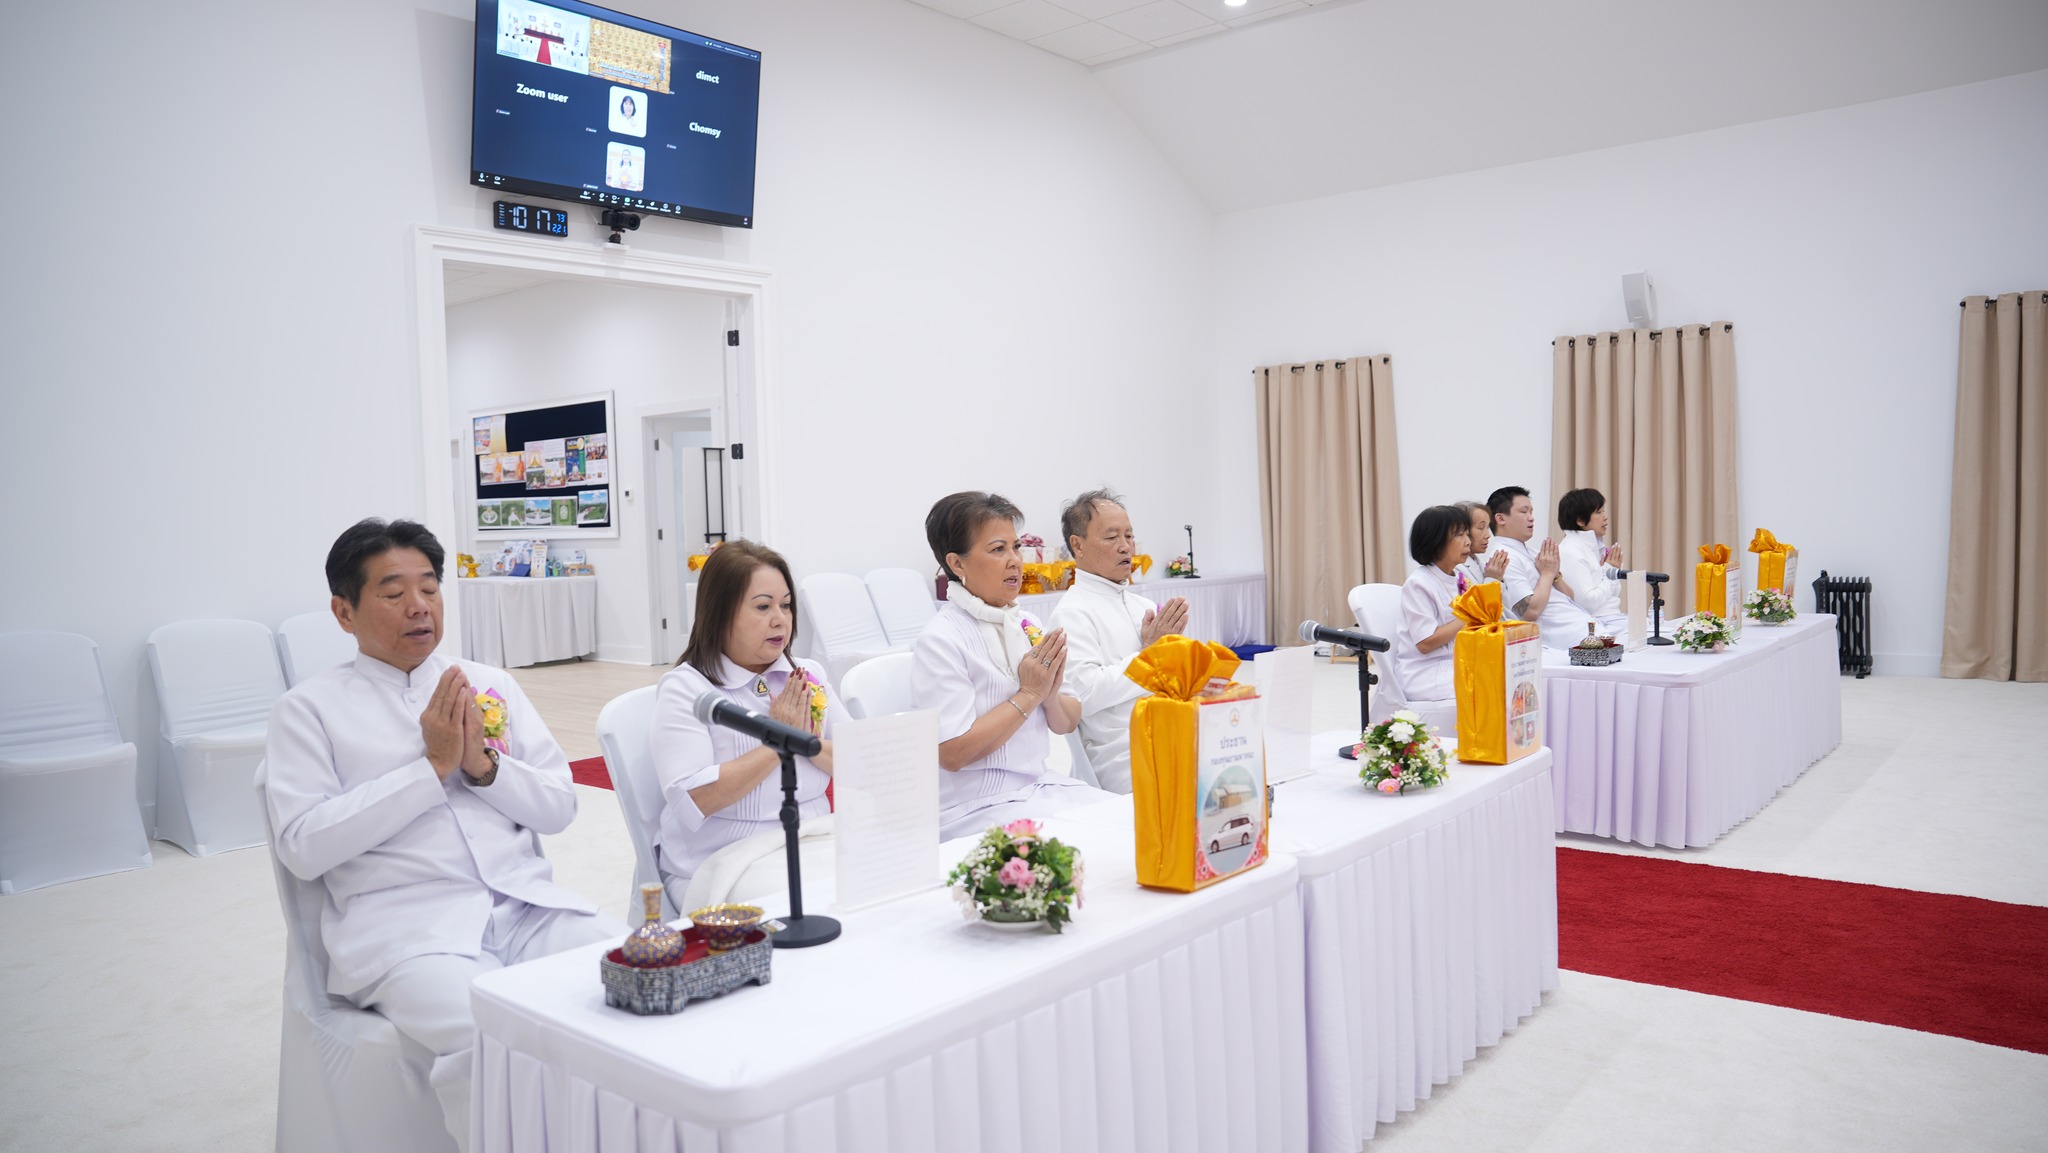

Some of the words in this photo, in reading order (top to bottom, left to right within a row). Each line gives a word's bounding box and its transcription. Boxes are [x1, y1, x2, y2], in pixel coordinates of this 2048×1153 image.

[696, 70, 719, 84] dimct
[516, 83, 545, 98] Zoom
[547, 92, 569, 103] user
[689, 122, 721, 139] Chomsy
